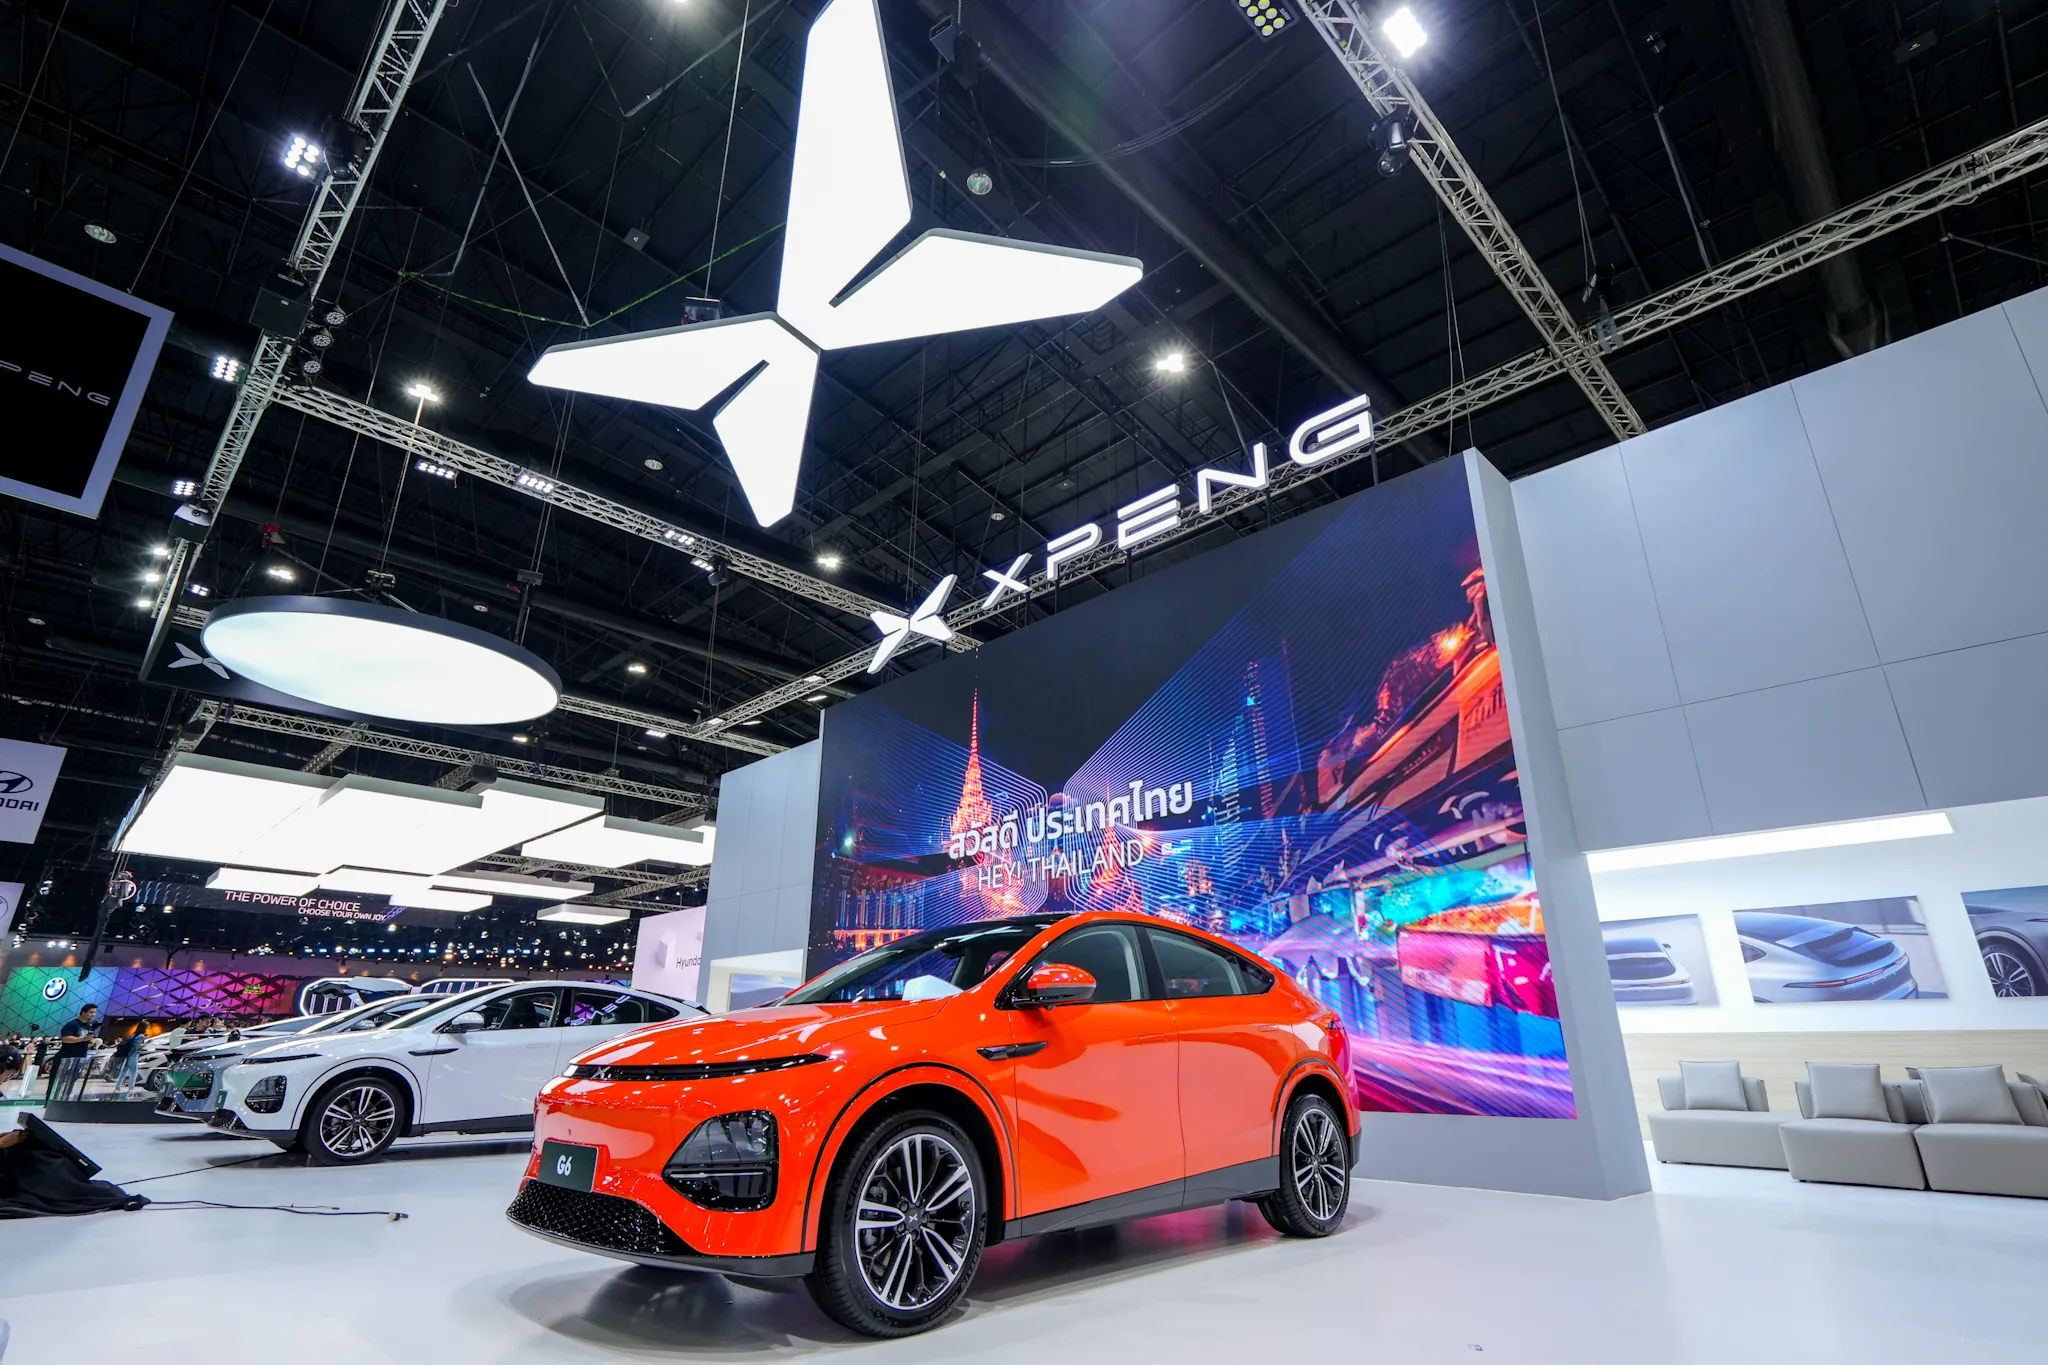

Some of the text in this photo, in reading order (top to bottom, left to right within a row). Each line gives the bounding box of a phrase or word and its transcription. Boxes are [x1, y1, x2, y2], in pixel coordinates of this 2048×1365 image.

[980, 393, 1375, 610] XPENG
[948, 779, 1194, 860] สวัสดี ประเทศไทย
[978, 839, 1144, 891] HEY! THAILAND
[225, 890, 361, 912] THE POWER OF CHOICE
[298, 907, 331, 917] CHOOSE
[332, 910, 353, 919] YOUR
[372, 913, 386, 921] JOY
[556, 1154, 573, 1176] G6
